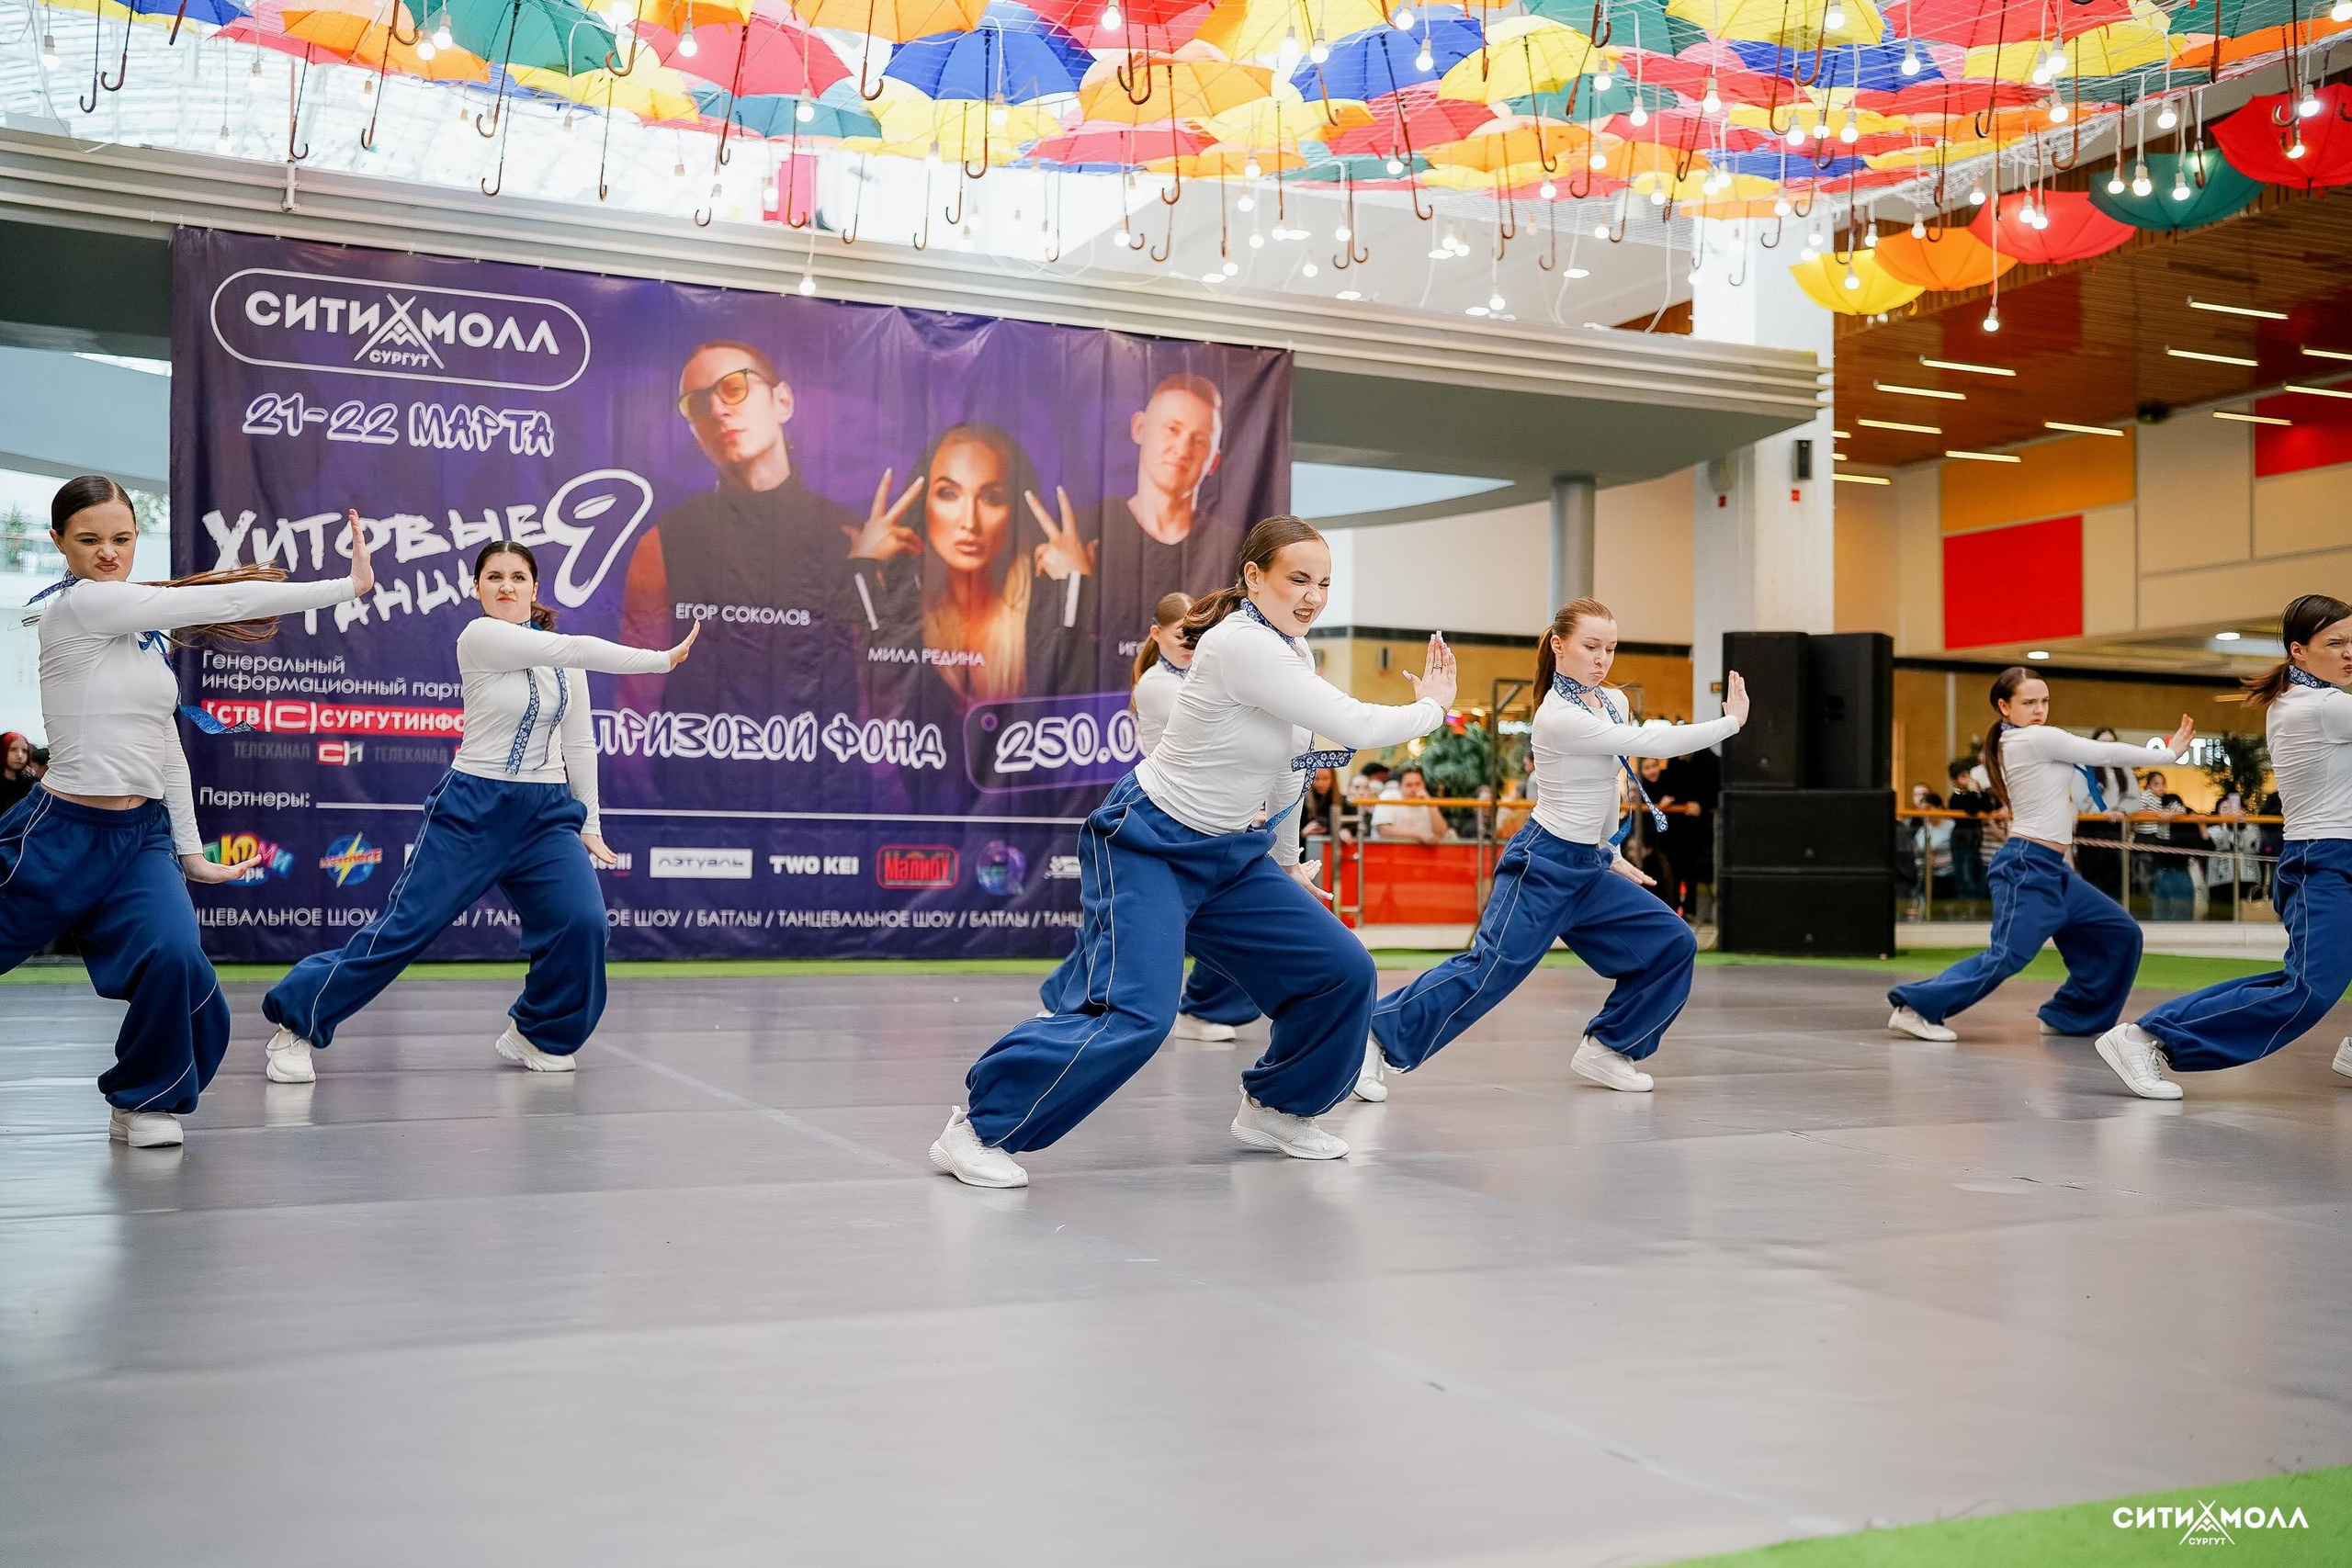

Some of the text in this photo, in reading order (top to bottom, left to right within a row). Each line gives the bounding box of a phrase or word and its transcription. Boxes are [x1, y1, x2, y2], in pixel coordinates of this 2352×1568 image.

[244, 289, 561, 355] СИТИ МОЛЛ
[368, 349, 430, 367] СУРГУТ
[242, 392, 555, 458] 21-22 МАРТА
[675, 603, 810, 626] ЕГОР СОКОЛОВ
[202, 649, 346, 674] Генеральный
[867, 647, 986, 667] МИЛА РЕДИНА
[202, 672, 406, 696] информационный
[591, 707, 819, 762] ПРИЗОВОЙ
[993, 708, 1146, 774] 250.0
[232, 739, 311, 761] ТЕЛЕКАНАЛ
[198, 786, 311, 811] Партнеры:
[768, 854, 820, 875] TWO
[327, 907, 379, 928] ШОУ
[634, 908, 682, 928] ШОУ
[696, 908, 763, 928] БАТТЛЫ
[776, 908, 910, 929] ТАНЦЕВАЛЬНОЕ
[912, 909, 956, 929] ШОУ
[969, 909, 1030, 929] БАТТЛЫ
